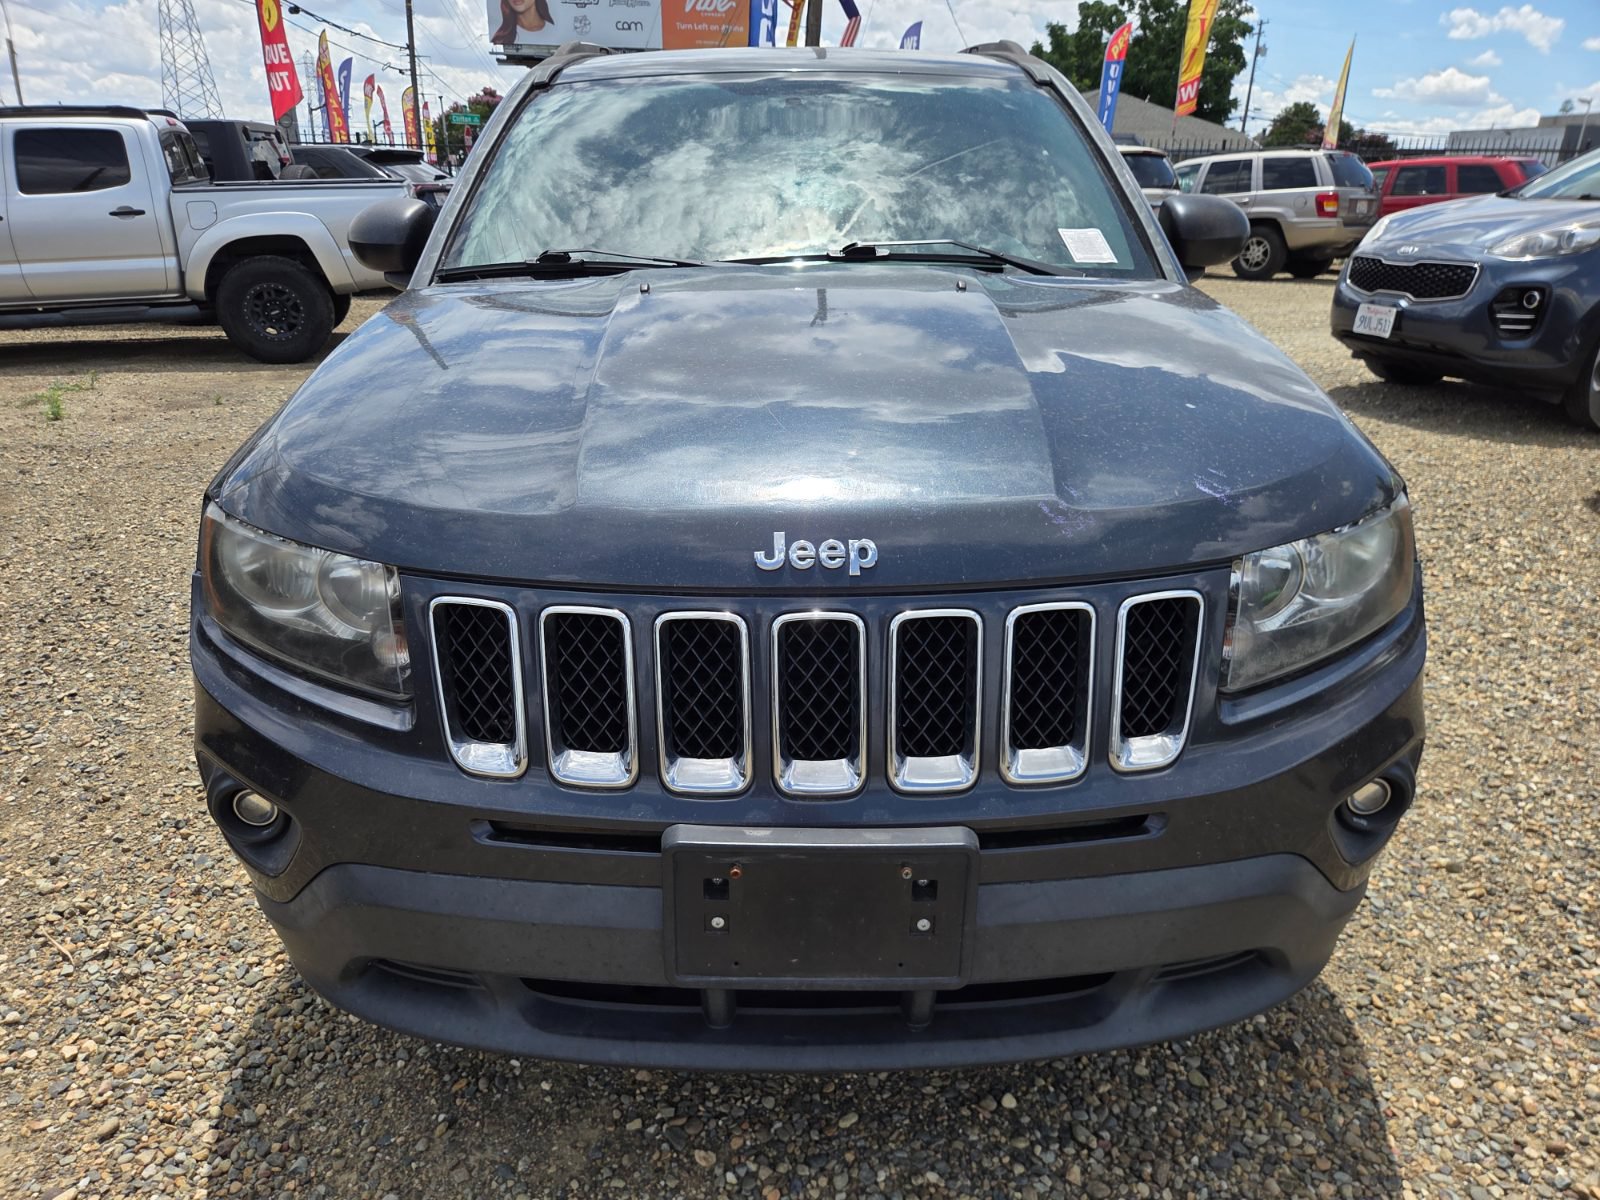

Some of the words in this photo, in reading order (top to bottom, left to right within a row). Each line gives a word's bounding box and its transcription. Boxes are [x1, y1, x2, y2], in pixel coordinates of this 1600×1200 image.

[676, 22, 693, 31] Turn
[694, 22, 709, 32] Left
[754, 531, 878, 576] Jeep
